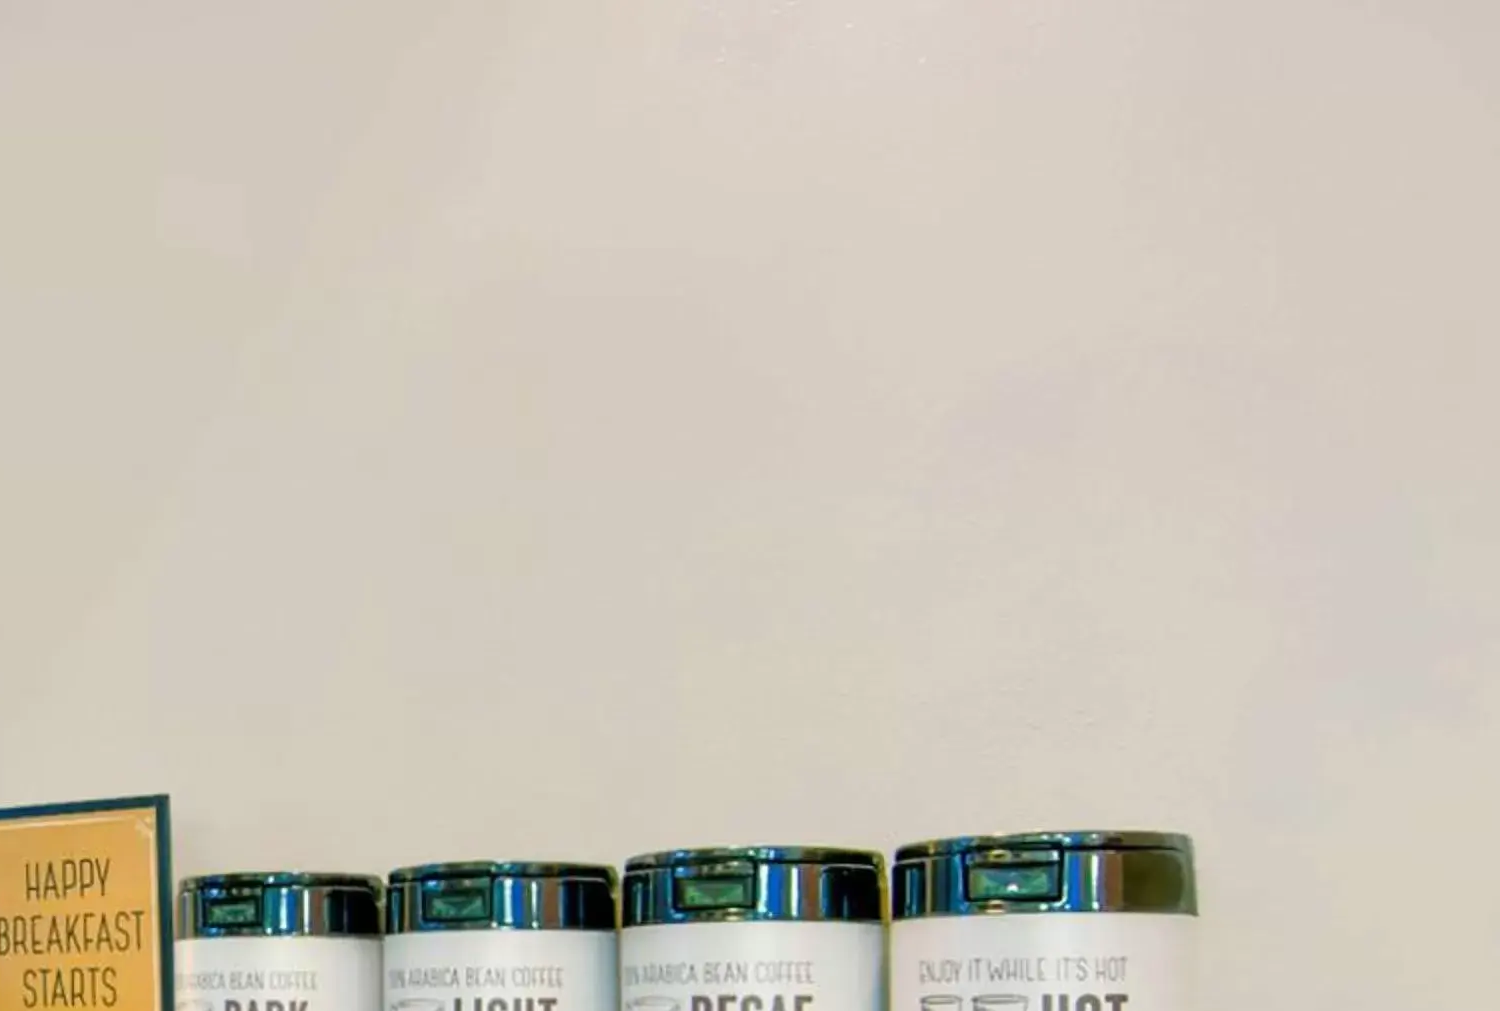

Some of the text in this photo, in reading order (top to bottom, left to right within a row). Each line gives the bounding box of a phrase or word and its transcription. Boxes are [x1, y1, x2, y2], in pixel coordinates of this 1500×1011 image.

[24, 858, 111, 901] HAPPY
[465, 967, 505, 989] BEAN
[512, 966, 565, 989] COFFEE
[703, 962, 748, 985] BEAN
[754, 961, 815, 986] COFFEE
[919, 956, 1128, 984] ENJOY IT WHILE IT'S HOT
[22, 966, 118, 1008] STARTS
